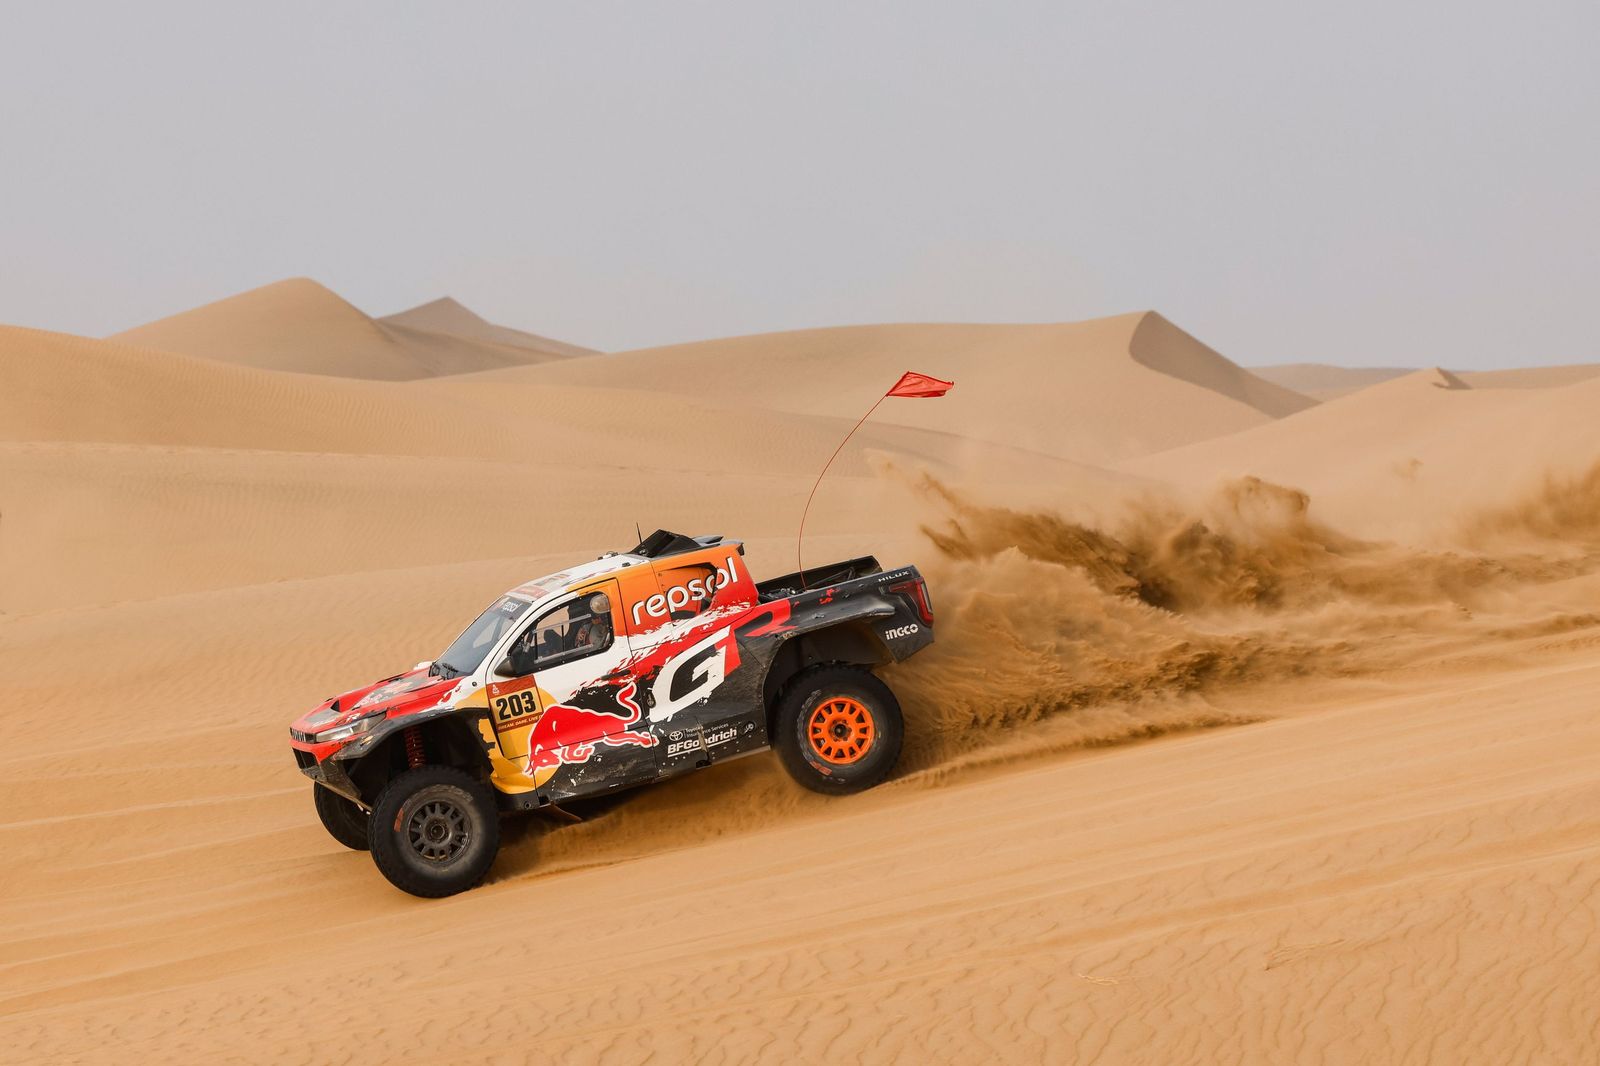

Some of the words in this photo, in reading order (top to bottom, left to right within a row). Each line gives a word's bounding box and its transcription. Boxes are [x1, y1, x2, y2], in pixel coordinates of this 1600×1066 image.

[878, 570, 909, 582] HILUX
[632, 557, 738, 626] repsol
[496, 691, 536, 720] 203
[667, 728, 737, 753] BFGodrich
